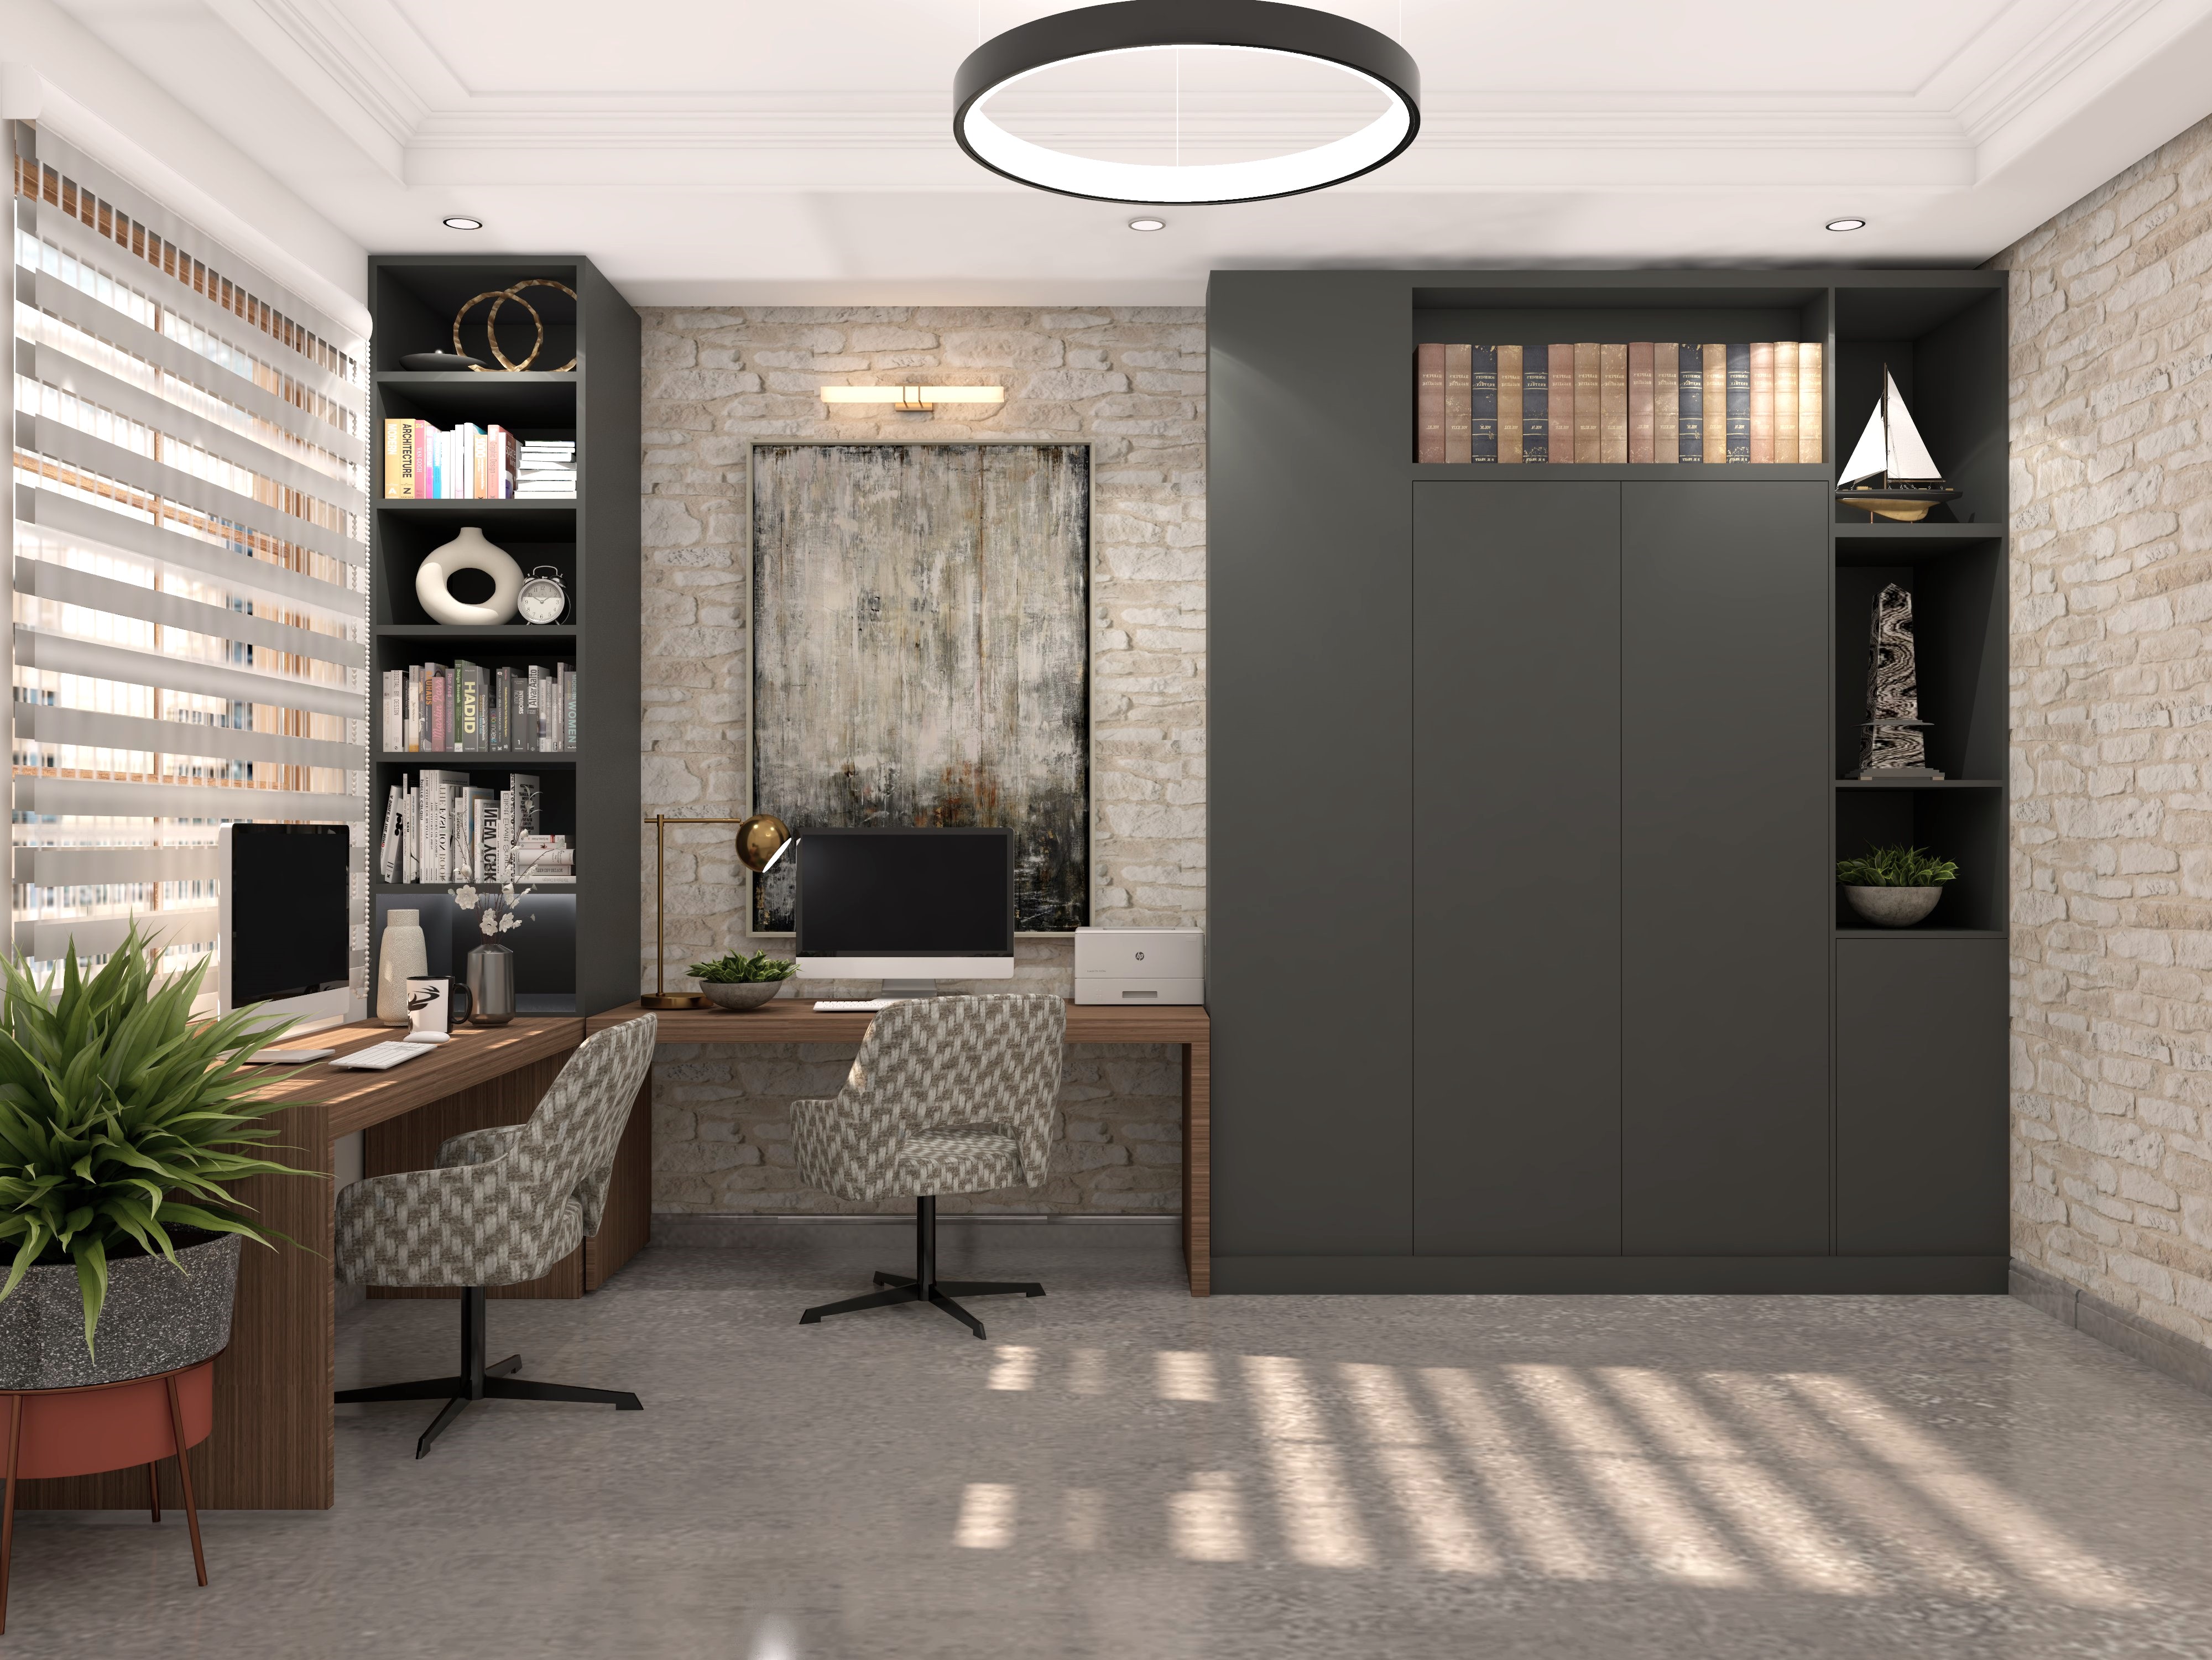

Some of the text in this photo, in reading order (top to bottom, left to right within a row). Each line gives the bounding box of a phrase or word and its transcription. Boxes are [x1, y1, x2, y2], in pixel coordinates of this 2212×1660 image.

[387, 424, 397, 455] MODERN
[403, 424, 411, 478] ARCHITECTURE
[476, 437, 486, 458] 1000
[529, 669, 537, 687] Aalto
[433, 678, 442, 739] Martin Parr
[464, 681, 476, 734] HADID
[529, 688, 537, 706] Alvar
[568, 701, 576, 743] WOMEN
[1135, 952, 1144, 960] hp
